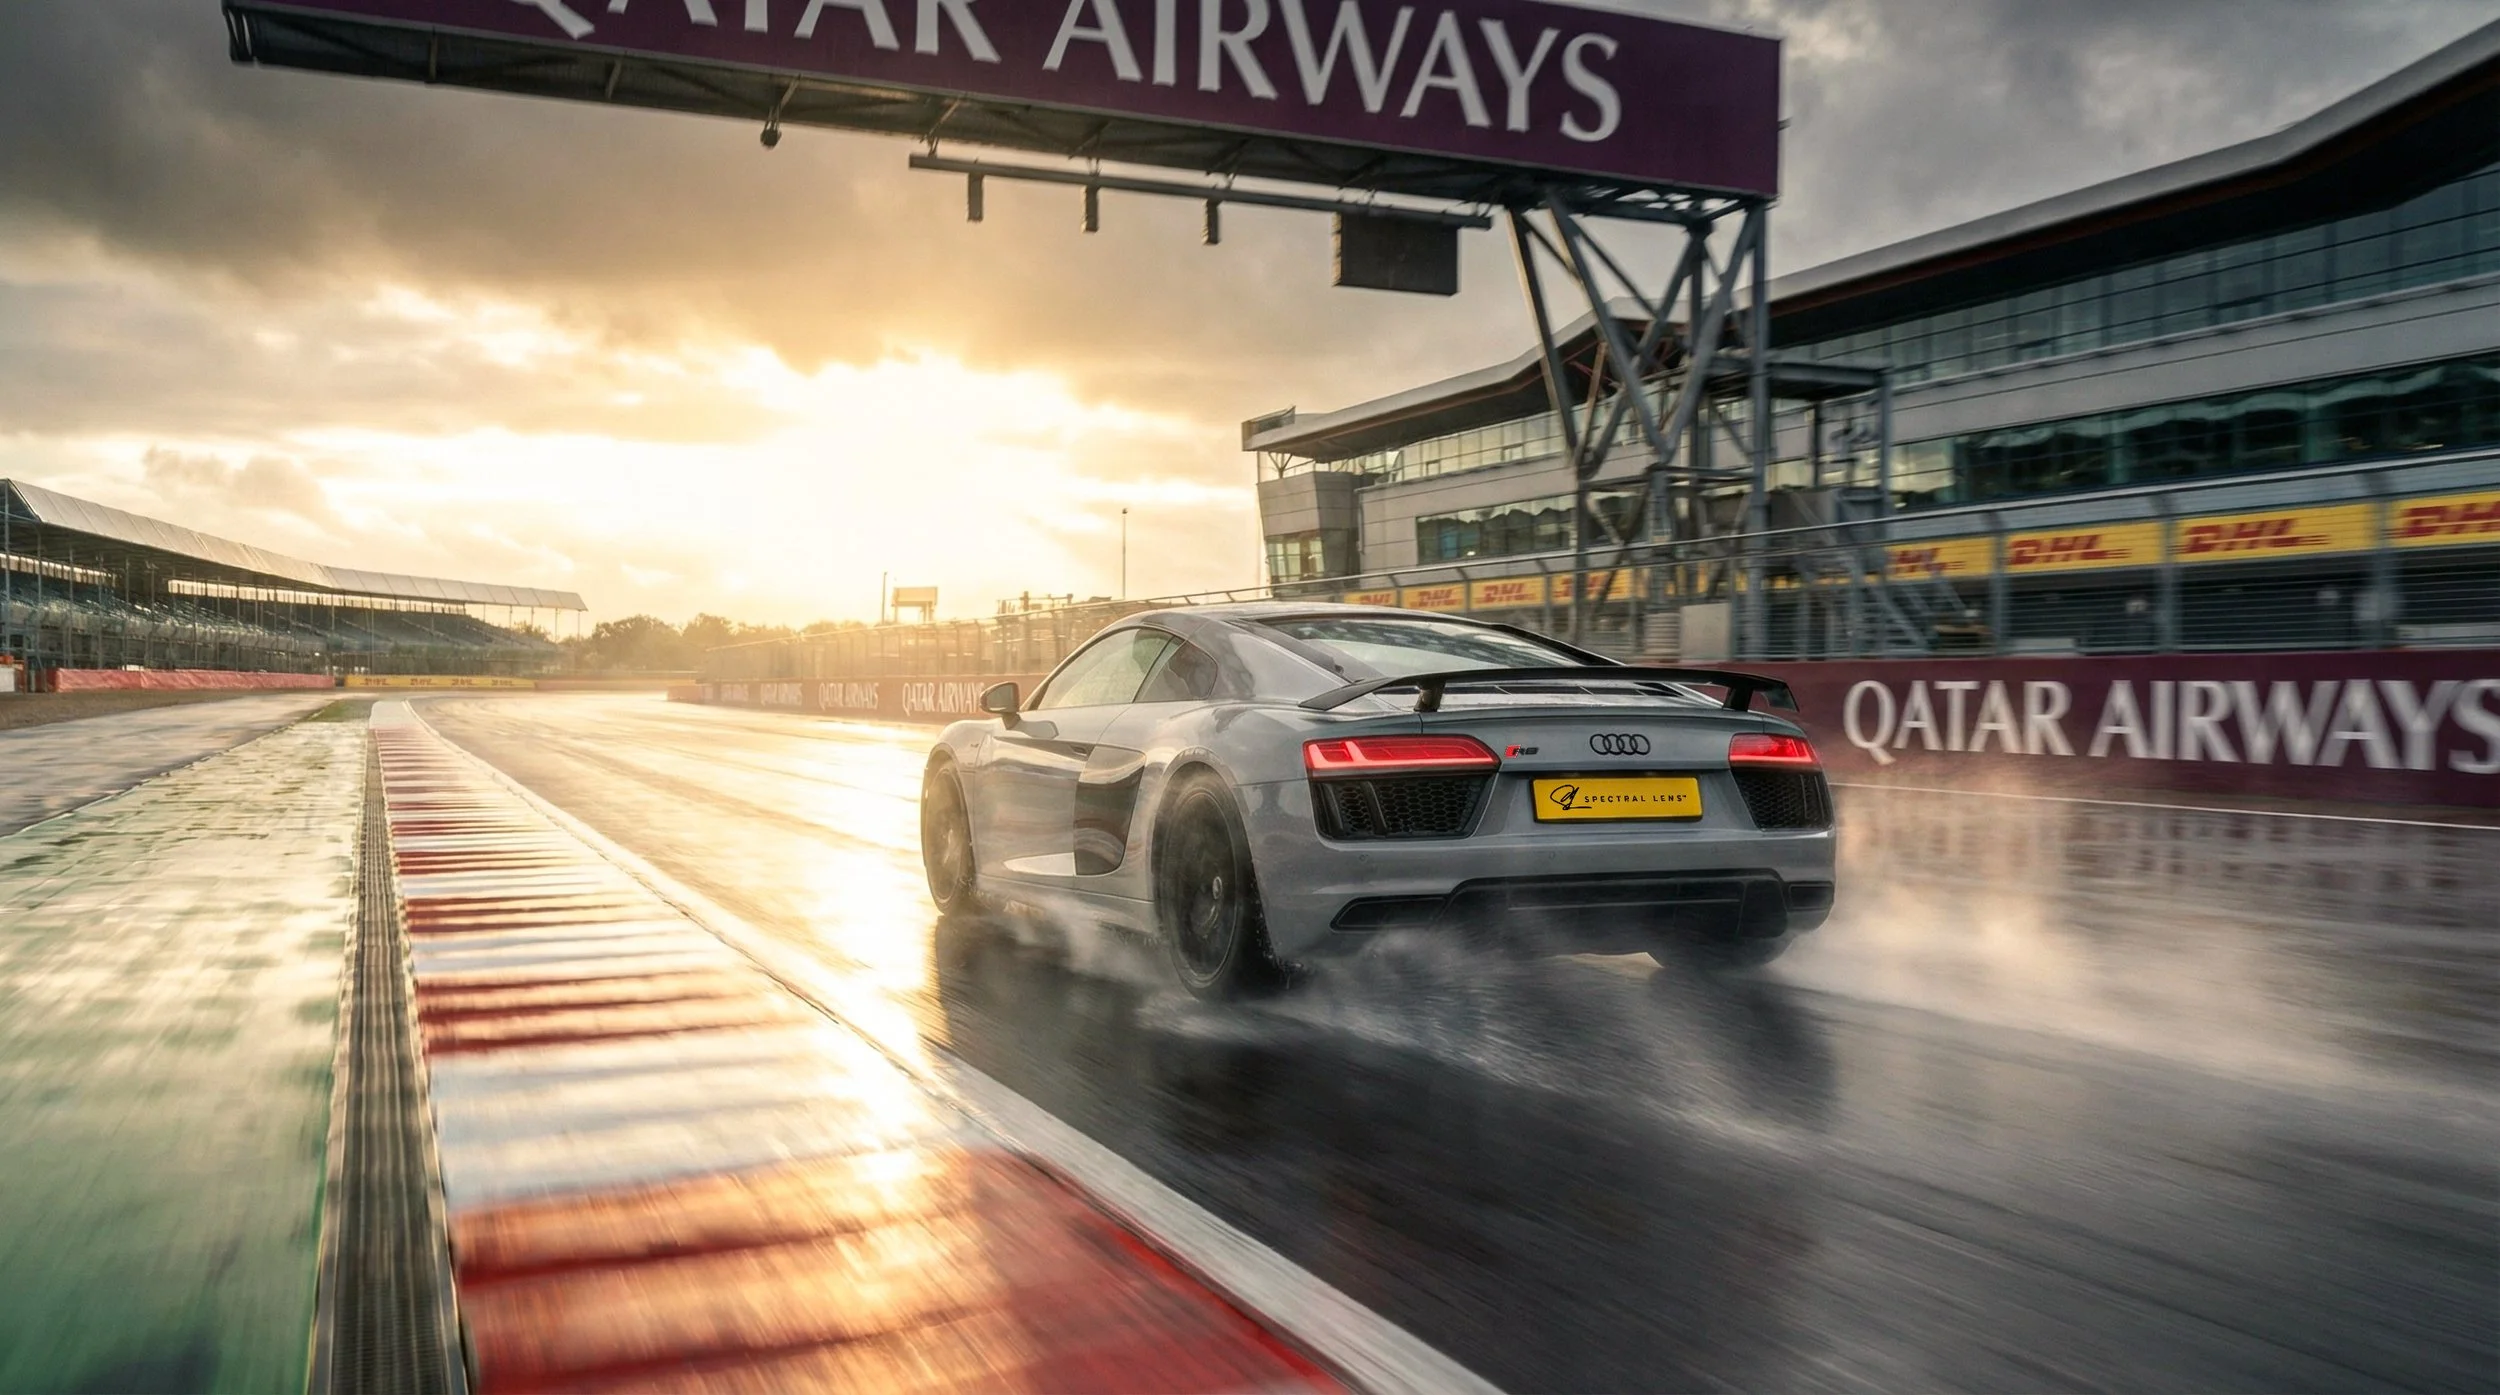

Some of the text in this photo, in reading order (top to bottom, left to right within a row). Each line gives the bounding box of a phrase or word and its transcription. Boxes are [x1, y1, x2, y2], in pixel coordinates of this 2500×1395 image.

[1042, 0, 1621, 142] AIRWAYS
[2009, 535, 2108, 565] DHL
[2184, 518, 2300, 553] DHL
[1418, 589, 1457, 608] DHL
[1484, 583, 1528, 603] DHL
[903, 682, 935, 716] QATAR
[1842, 679, 2500, 775] QATAR AIRWAYS
[1508, 746, 1539, 757] R8
[1584, 795, 1646, 803] SPECTRAL
